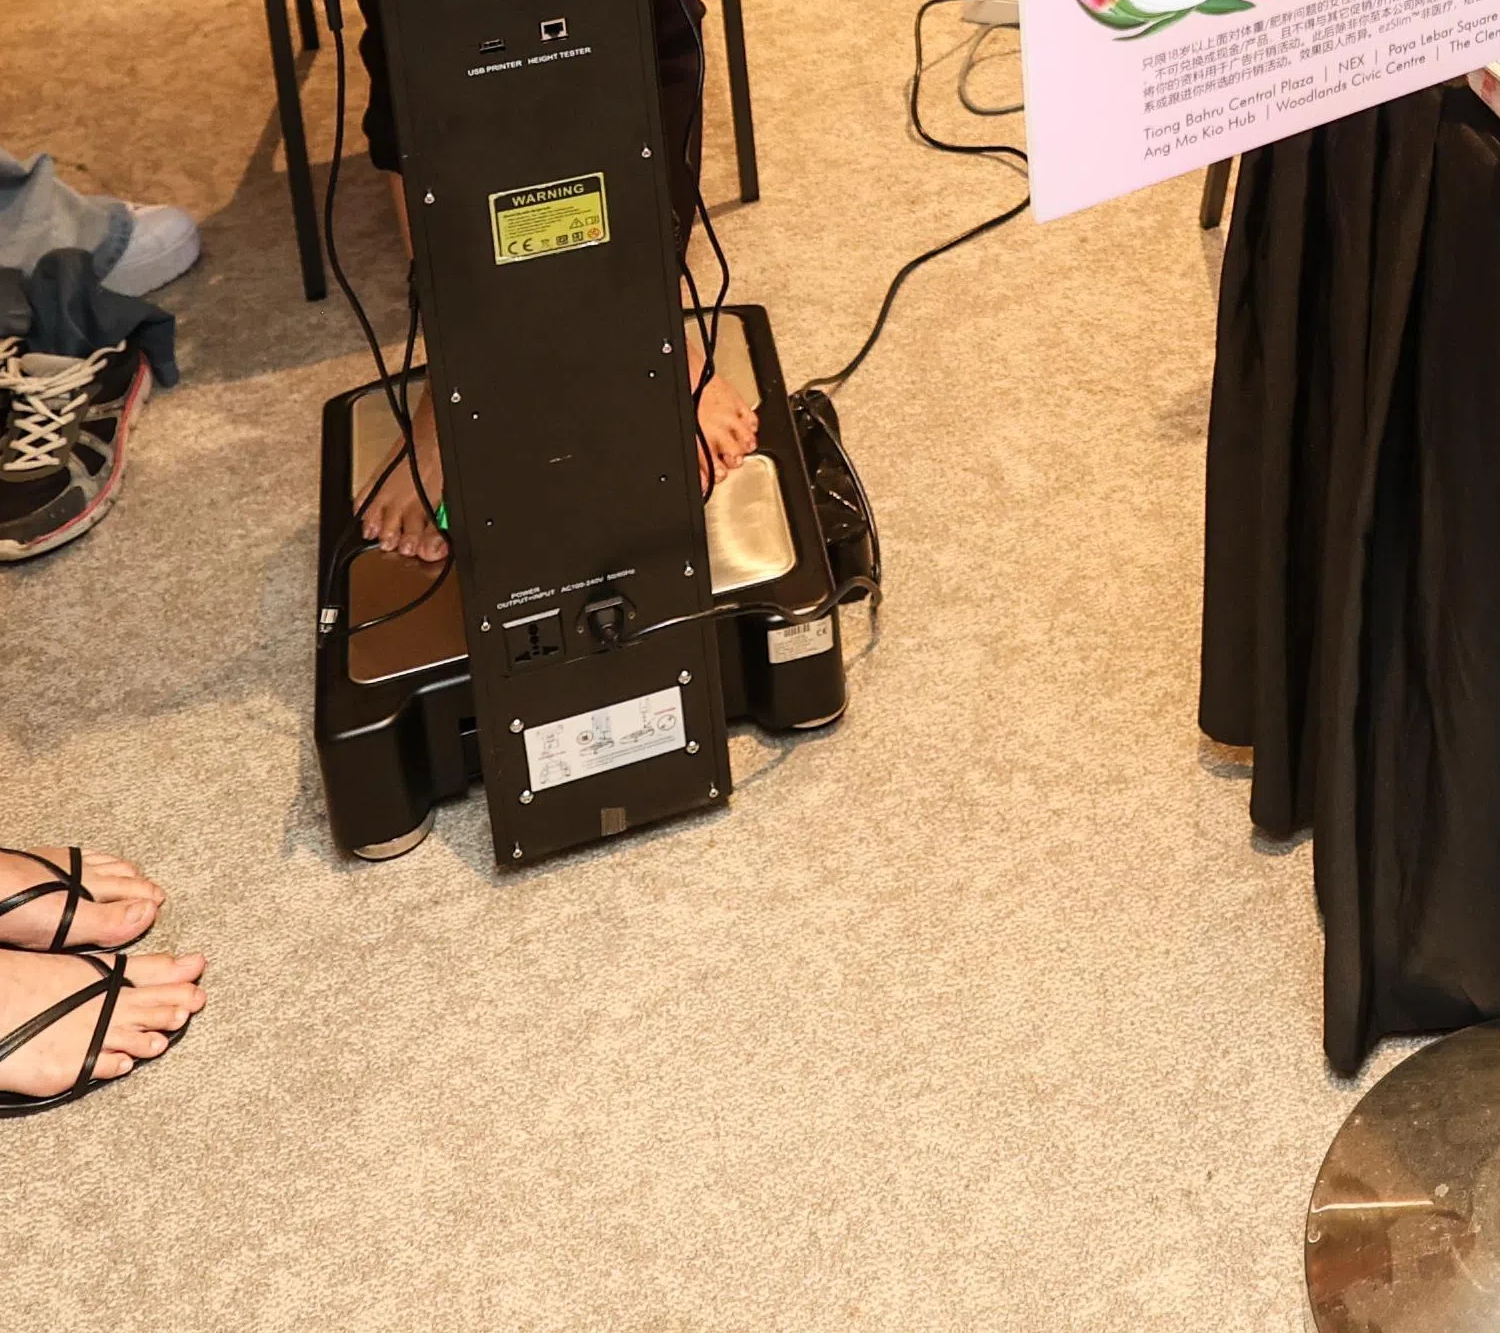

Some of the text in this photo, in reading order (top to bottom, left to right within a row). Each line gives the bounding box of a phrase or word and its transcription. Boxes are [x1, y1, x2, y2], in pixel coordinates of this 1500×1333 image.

[468, 60, 522, 77] USB PRINTER
[528, 47, 592, 65] HEIGHT TESTER
[1144, 121, 1181, 141] Tiong
[1185, 104, 1224, 126] Bahru
[1229, 84, 1277, 112] Central
[1281, 74, 1315, 95] Plaza
[1338, 54, 1366, 74] NEX
[1420, 26, 1453, 46] Lebar
[1457, 10, 1498, 33] Square
[1276, 83, 1347, 113] Woodlands
[1351, 67, 1381, 88] Civic
[1385, 52, 1426, 76] Centre
[512, 183, 585, 208] WARNING
